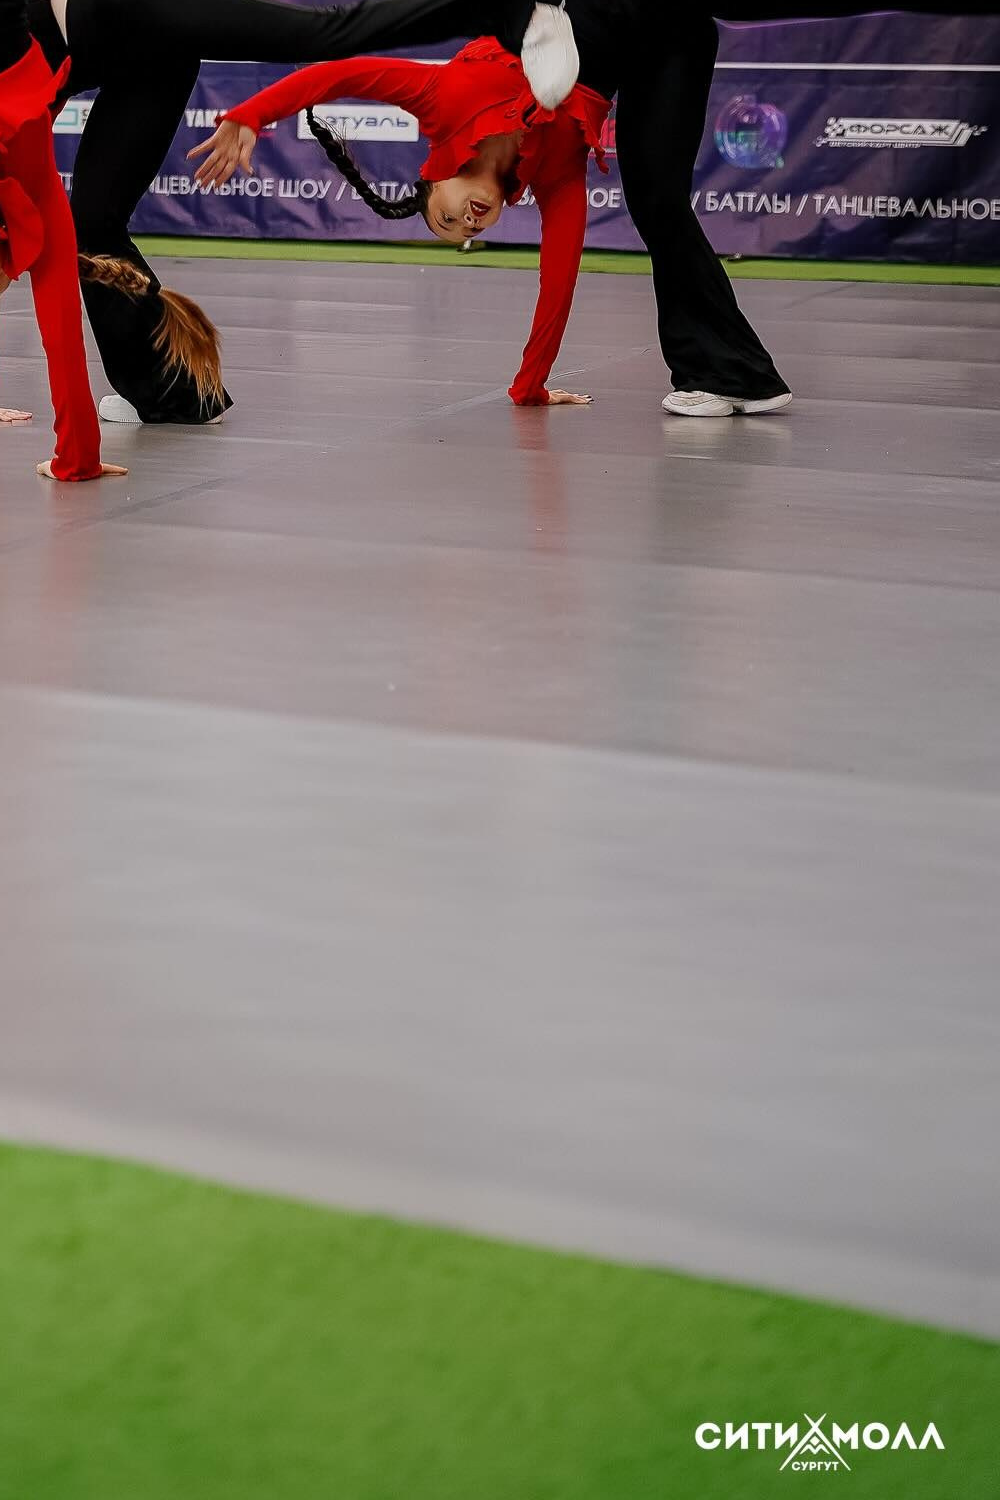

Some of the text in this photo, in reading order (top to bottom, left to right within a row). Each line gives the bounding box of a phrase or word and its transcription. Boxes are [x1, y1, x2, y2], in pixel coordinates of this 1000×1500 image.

[324, 114, 410, 129] этуаль
[849, 123, 950, 137] ФОРСАЖ
[150, 175, 275, 197] ЦЕВАЛЬНОЕ
[278, 178, 333, 199] ШОУ
[705, 190, 791, 214] БАТТЛЫ
[813, 194, 1000, 221] ТАНЦЕВАЛЬНОЕ
